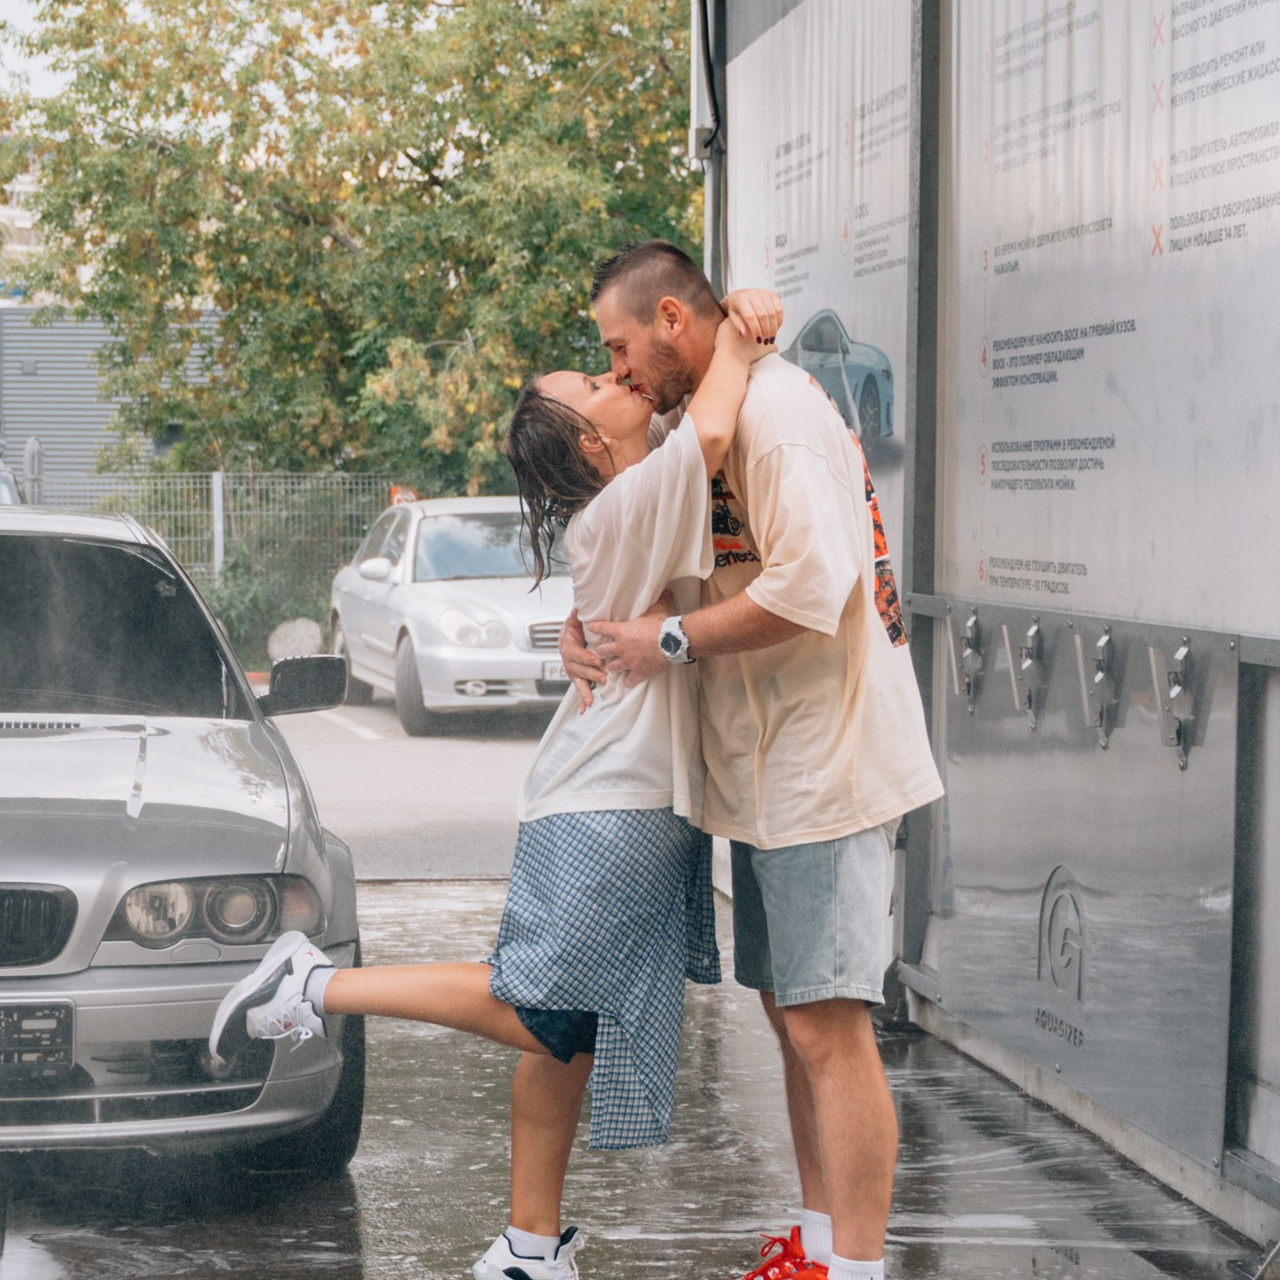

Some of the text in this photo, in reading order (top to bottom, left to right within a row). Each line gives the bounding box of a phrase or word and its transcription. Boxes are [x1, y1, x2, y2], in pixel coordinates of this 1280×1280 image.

[992, 336, 1028, 352] РЕКОМЕНДУЕМ
[1028, 334, 1035, 346] НЕ
[1036, 331, 1064, 346] НАНОСИТЬ
[1064, 328, 1078, 342] ВОСК
[1080, 326, 1088, 338] НА
[1089, 319, 1115, 337] ГРЯЗНЫЙ
[992, 358, 1005, 370] ВОСК
[1009, 356, 1018, 368] ЭТО
[1019, 352, 1042, 368] ПОЛИМЕР
[1044, 348, 1084, 364] ОБЛАДАЮЩИМ
[992, 374, 1019, 389] ЭФФЕКТОМ
[1033, 439, 1062, 452] ПРОГРАММ
[990, 574, 998, 586] ПРИ
[1034, 1006, 1084, 1050] AQUAGIZER
